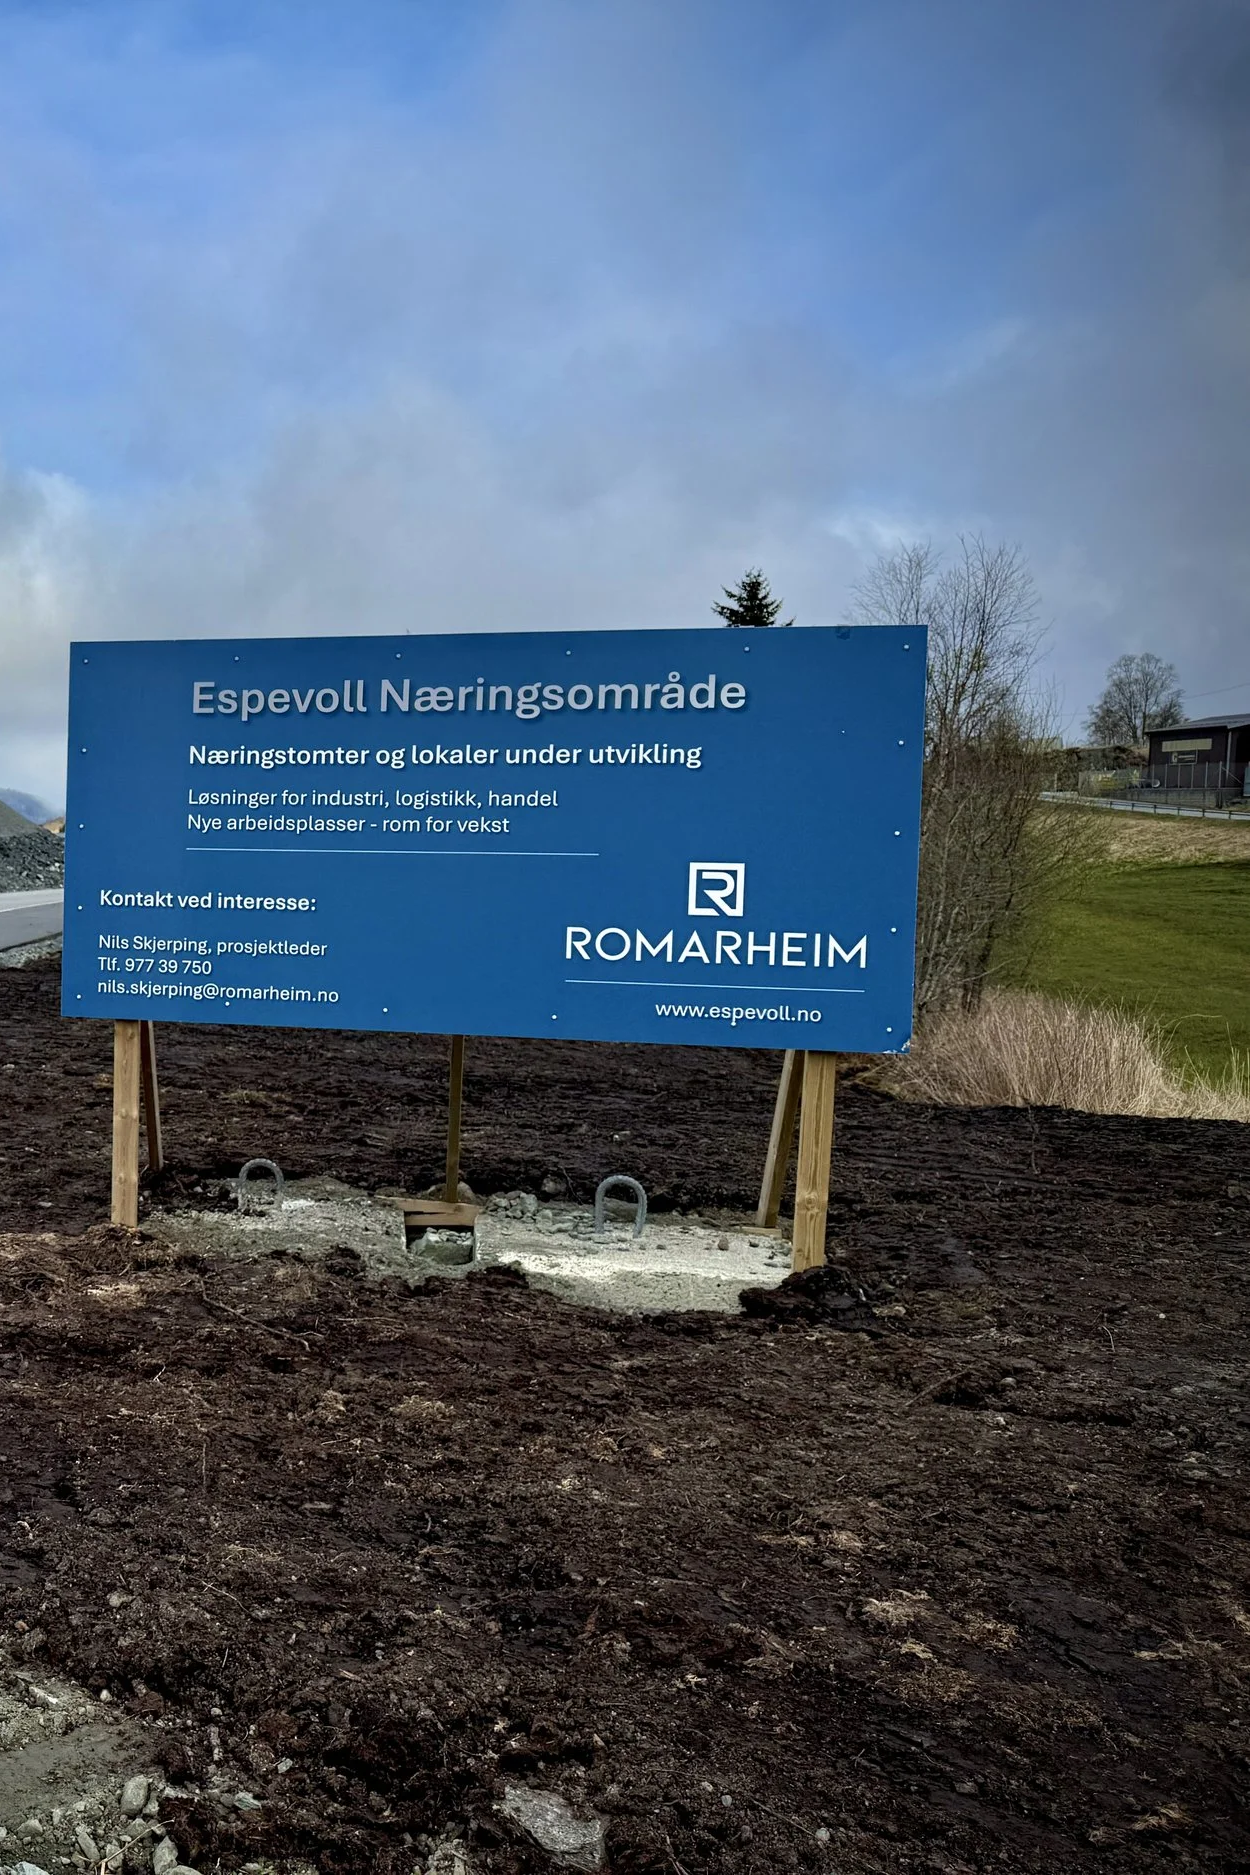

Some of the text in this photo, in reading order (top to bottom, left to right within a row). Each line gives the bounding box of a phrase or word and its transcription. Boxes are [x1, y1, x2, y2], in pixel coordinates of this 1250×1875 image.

[193, 671, 747, 722] Espevoll Næringsområde
[188, 743, 703, 769] Næringstomter og lokaler under utvikling
[188, 788, 558, 809] Løsninger for industri, logistikk, handel
[187, 814, 222, 834] Nye
[226, 814, 366, 835] arbeidsplasser
[382, 819, 421, 832] rom
[425, 815, 454, 833] for
[456, 817, 510, 833] vekst
[100, 889, 317, 911] Kontakt ved interesse:
[99, 934, 328, 957] Nils Skjerping, prosjektleder
[565, 926, 867, 969] ROMARHEIM
[98, 956, 212, 975] Tlf. 977 39 750
[97, 979, 339, 1003] nils.skjerping@romarheim.no
[655, 1004, 823, 1027] www.espevoll.no
